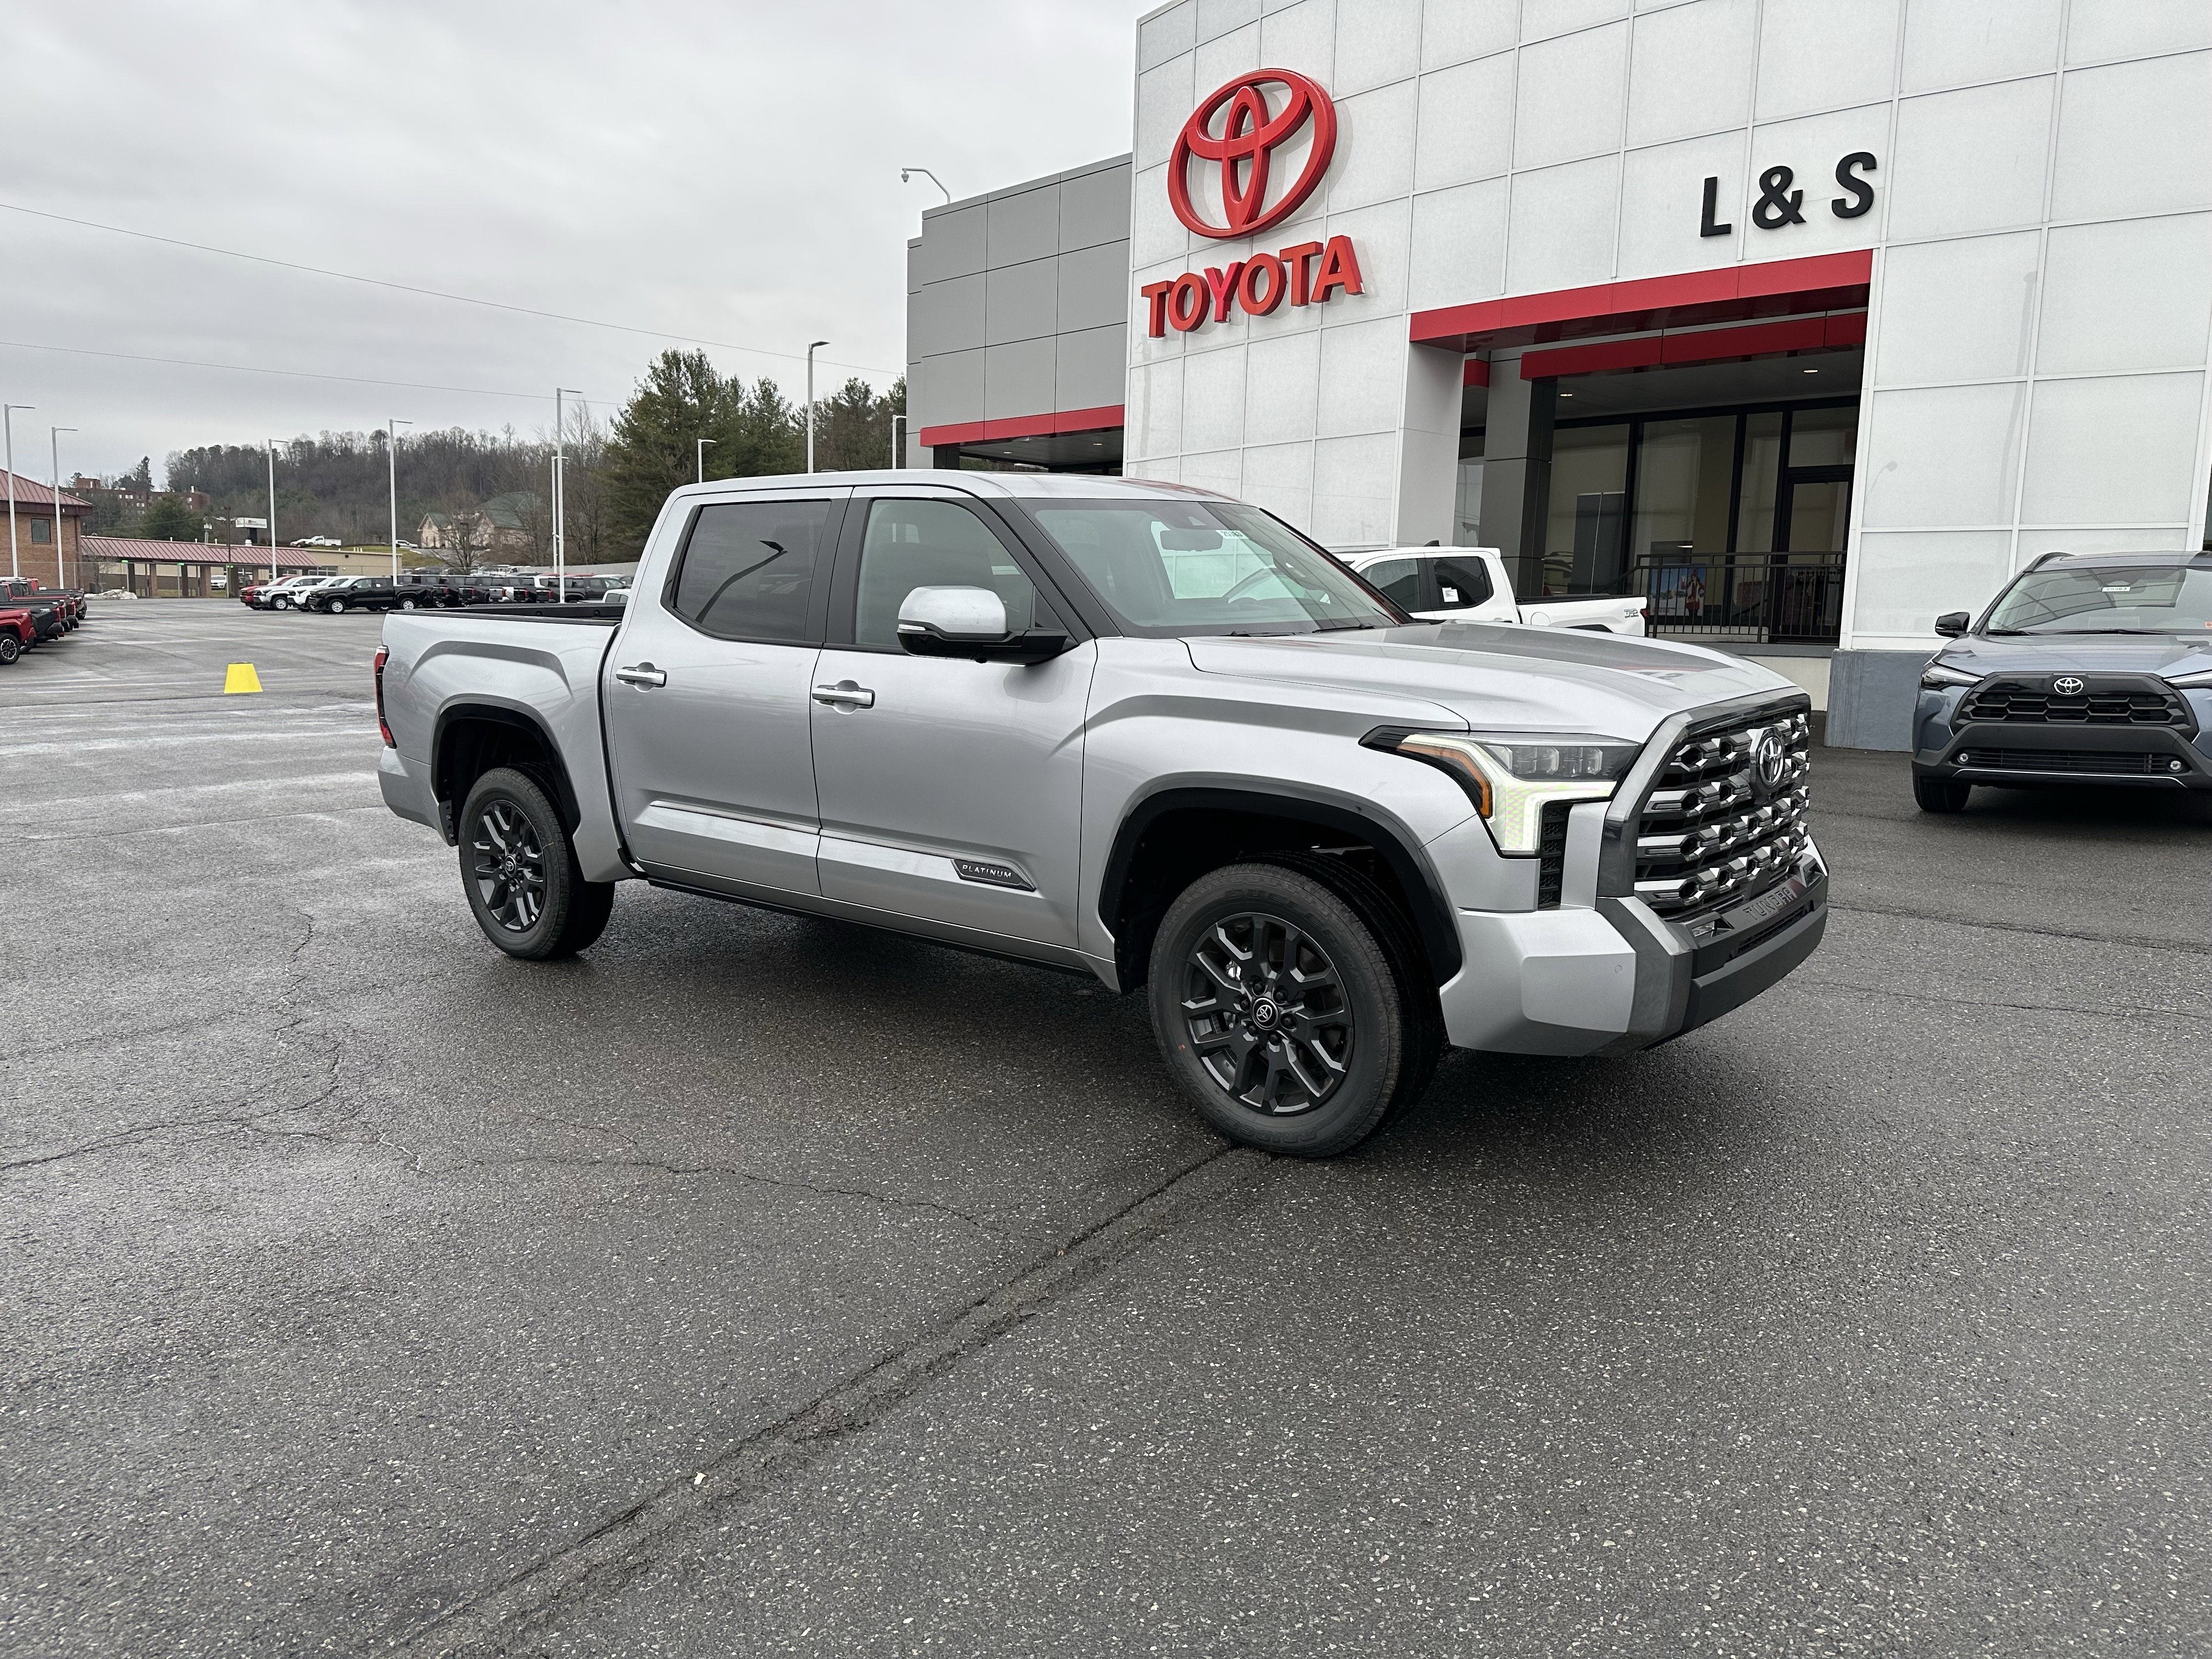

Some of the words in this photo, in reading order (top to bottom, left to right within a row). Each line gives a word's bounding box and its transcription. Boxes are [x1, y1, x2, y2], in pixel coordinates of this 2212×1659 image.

[1700, 176, 1732, 238] L
[1752, 165, 1807, 229] &
[1831, 151, 1877, 219] S
[1141, 234, 1365, 338] TOYOTA
[962, 864, 1012, 879] PLATINUM
[1742, 887, 1797, 920] TUNDRA
[1224, 887, 1341, 949] DUELER
[1172, 1054, 1318, 1143] BRIDGESTONE
